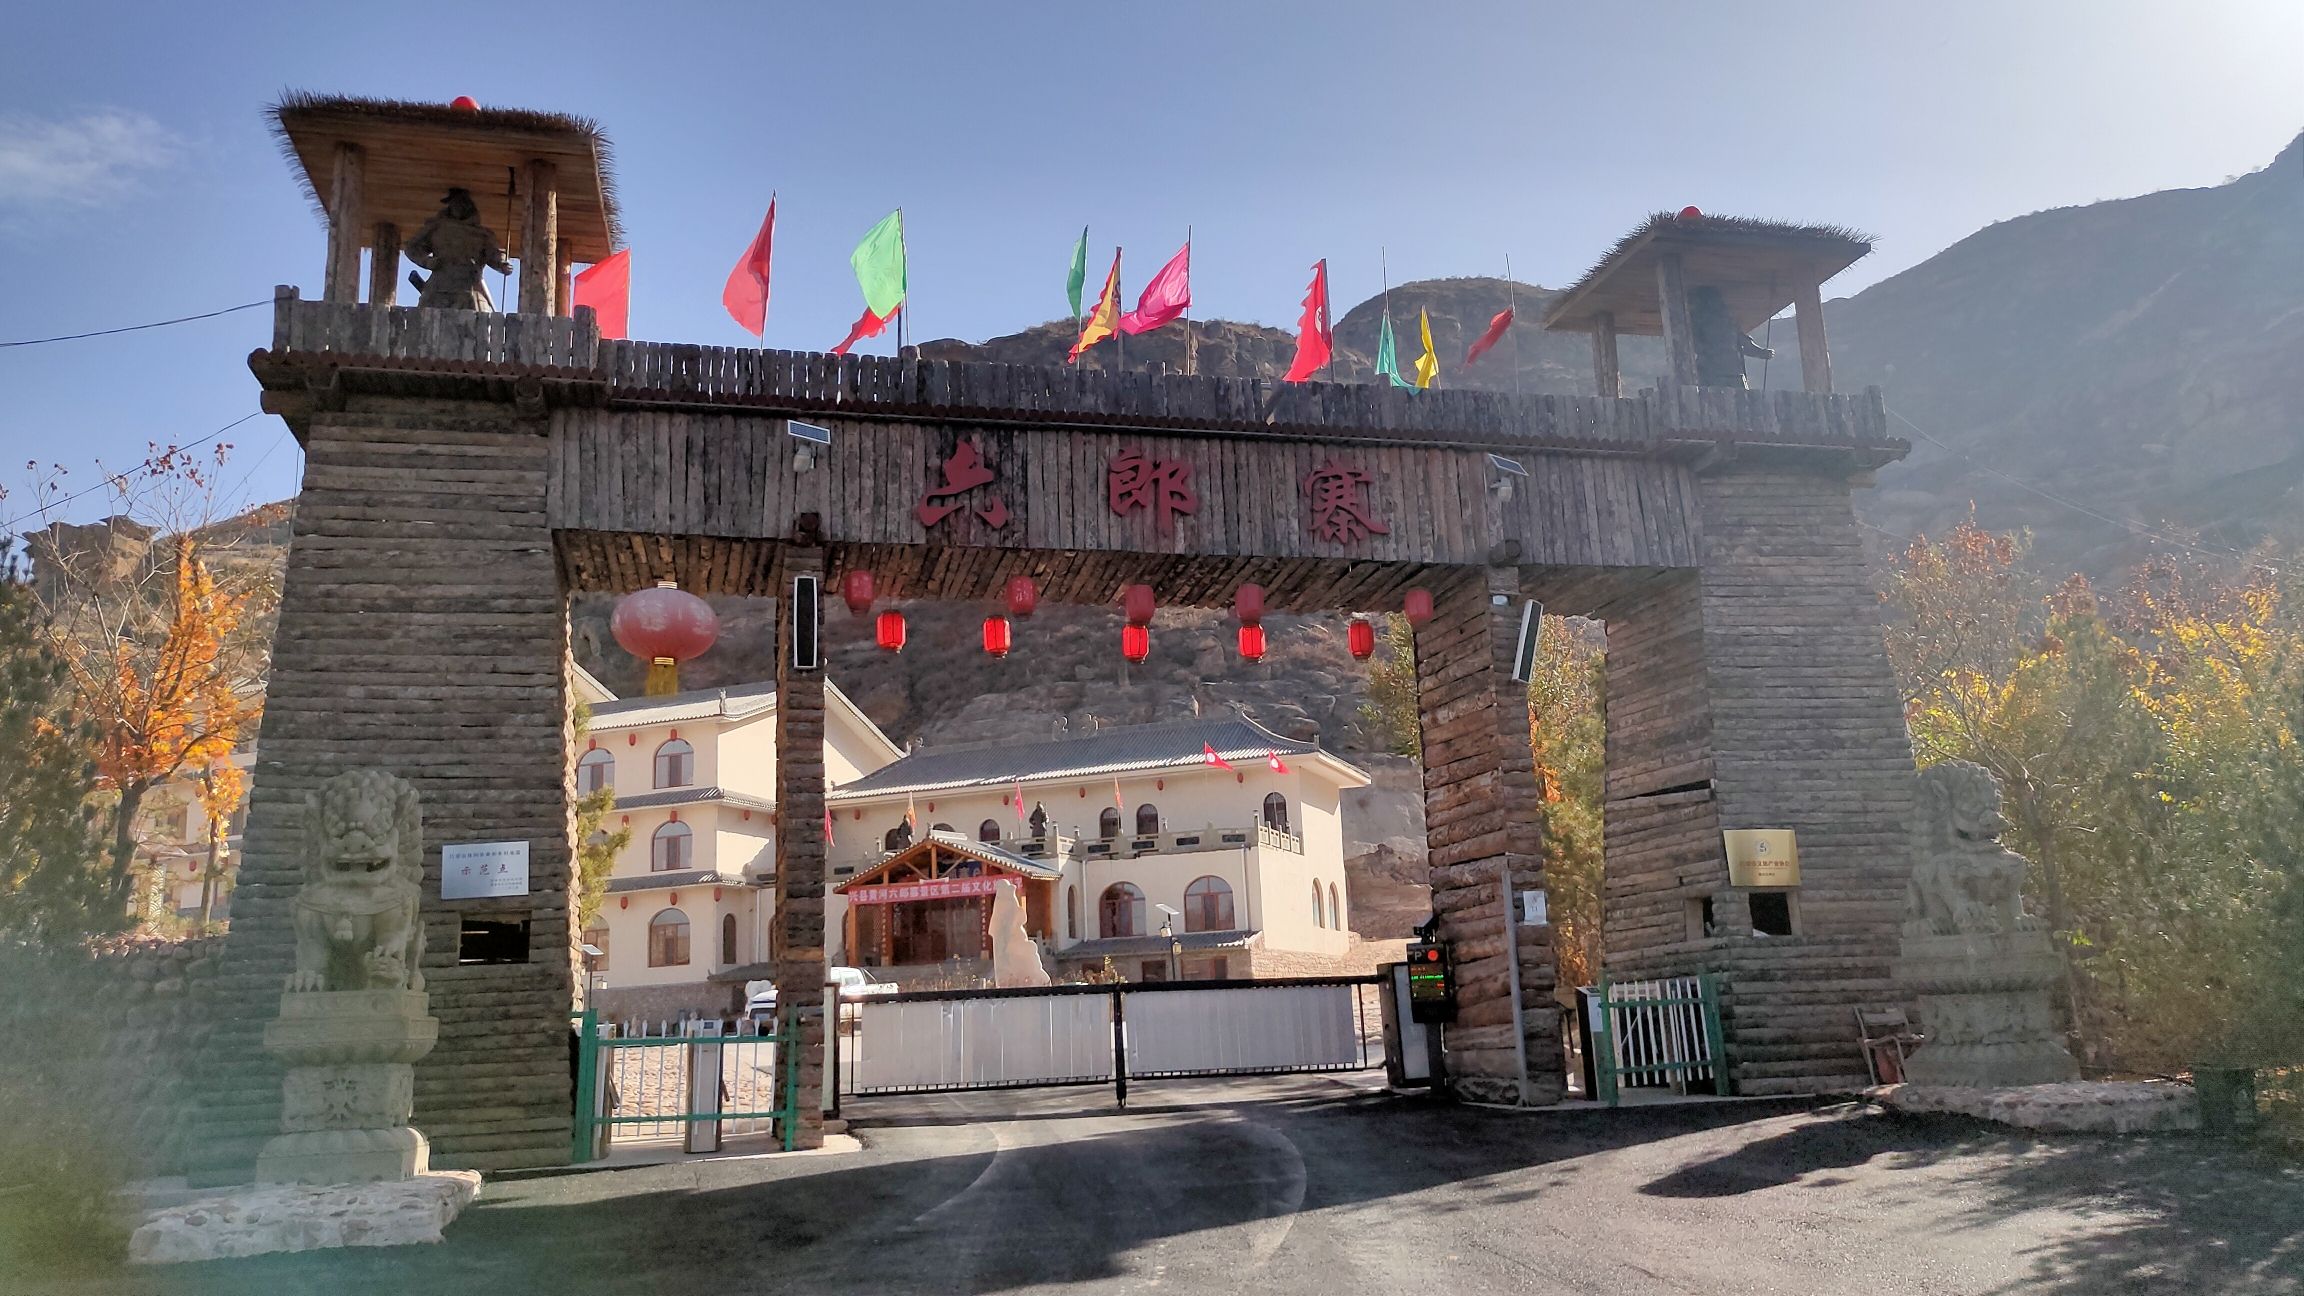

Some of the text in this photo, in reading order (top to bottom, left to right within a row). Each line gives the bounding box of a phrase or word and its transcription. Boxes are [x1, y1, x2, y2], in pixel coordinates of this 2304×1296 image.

[918, 438, 1391, 544] 六郎寨
[850, 877, 1023, 902] 兴县黄河六郎寨景区第二届文化节
